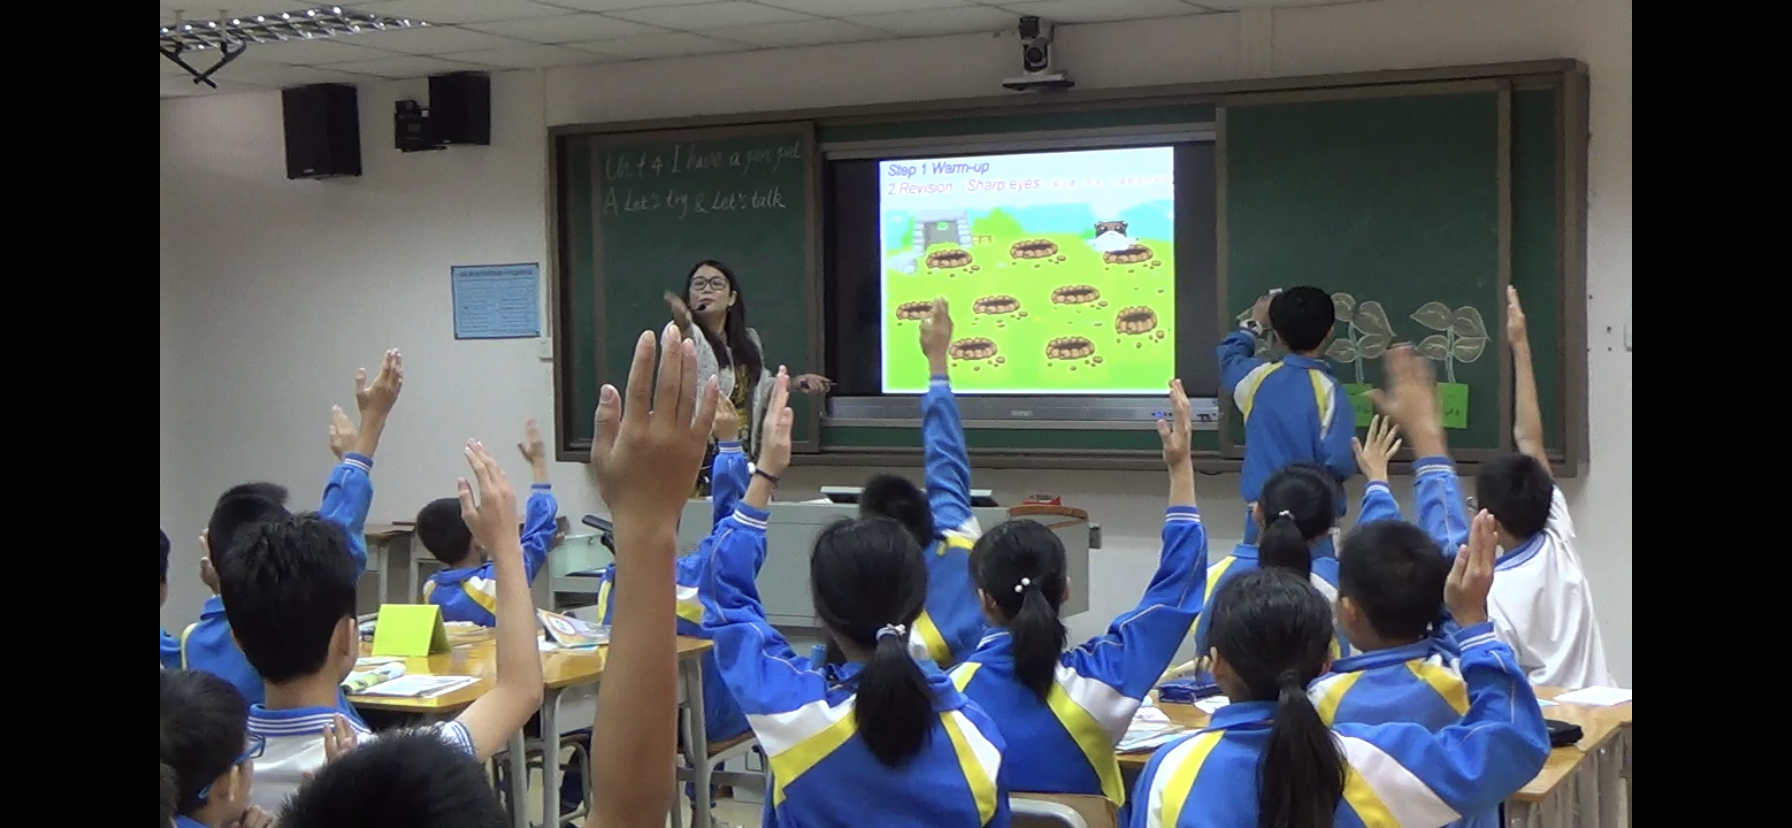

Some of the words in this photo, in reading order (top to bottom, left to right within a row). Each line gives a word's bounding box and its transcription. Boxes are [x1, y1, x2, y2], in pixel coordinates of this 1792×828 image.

[651, 155, 664, 177] 4
[671, 144, 682, 174] I
[686, 141, 722, 171] have
[728, 151, 741, 167] a
[887, 163, 917, 178] Step
[921, 162, 928, 176] 1
[931, 161, 990, 176] Warm-up
[899, 182, 953, 194] Revision
[967, 178, 1006, 193] Sharp
[1009, 178, 1041, 192] eyes
[604, 186, 619, 216] A
[665, 189, 689, 220] try
[694, 190, 709, 214] &
[711, 190, 748, 211] Let's
[751, 185, 787, 209] talk
